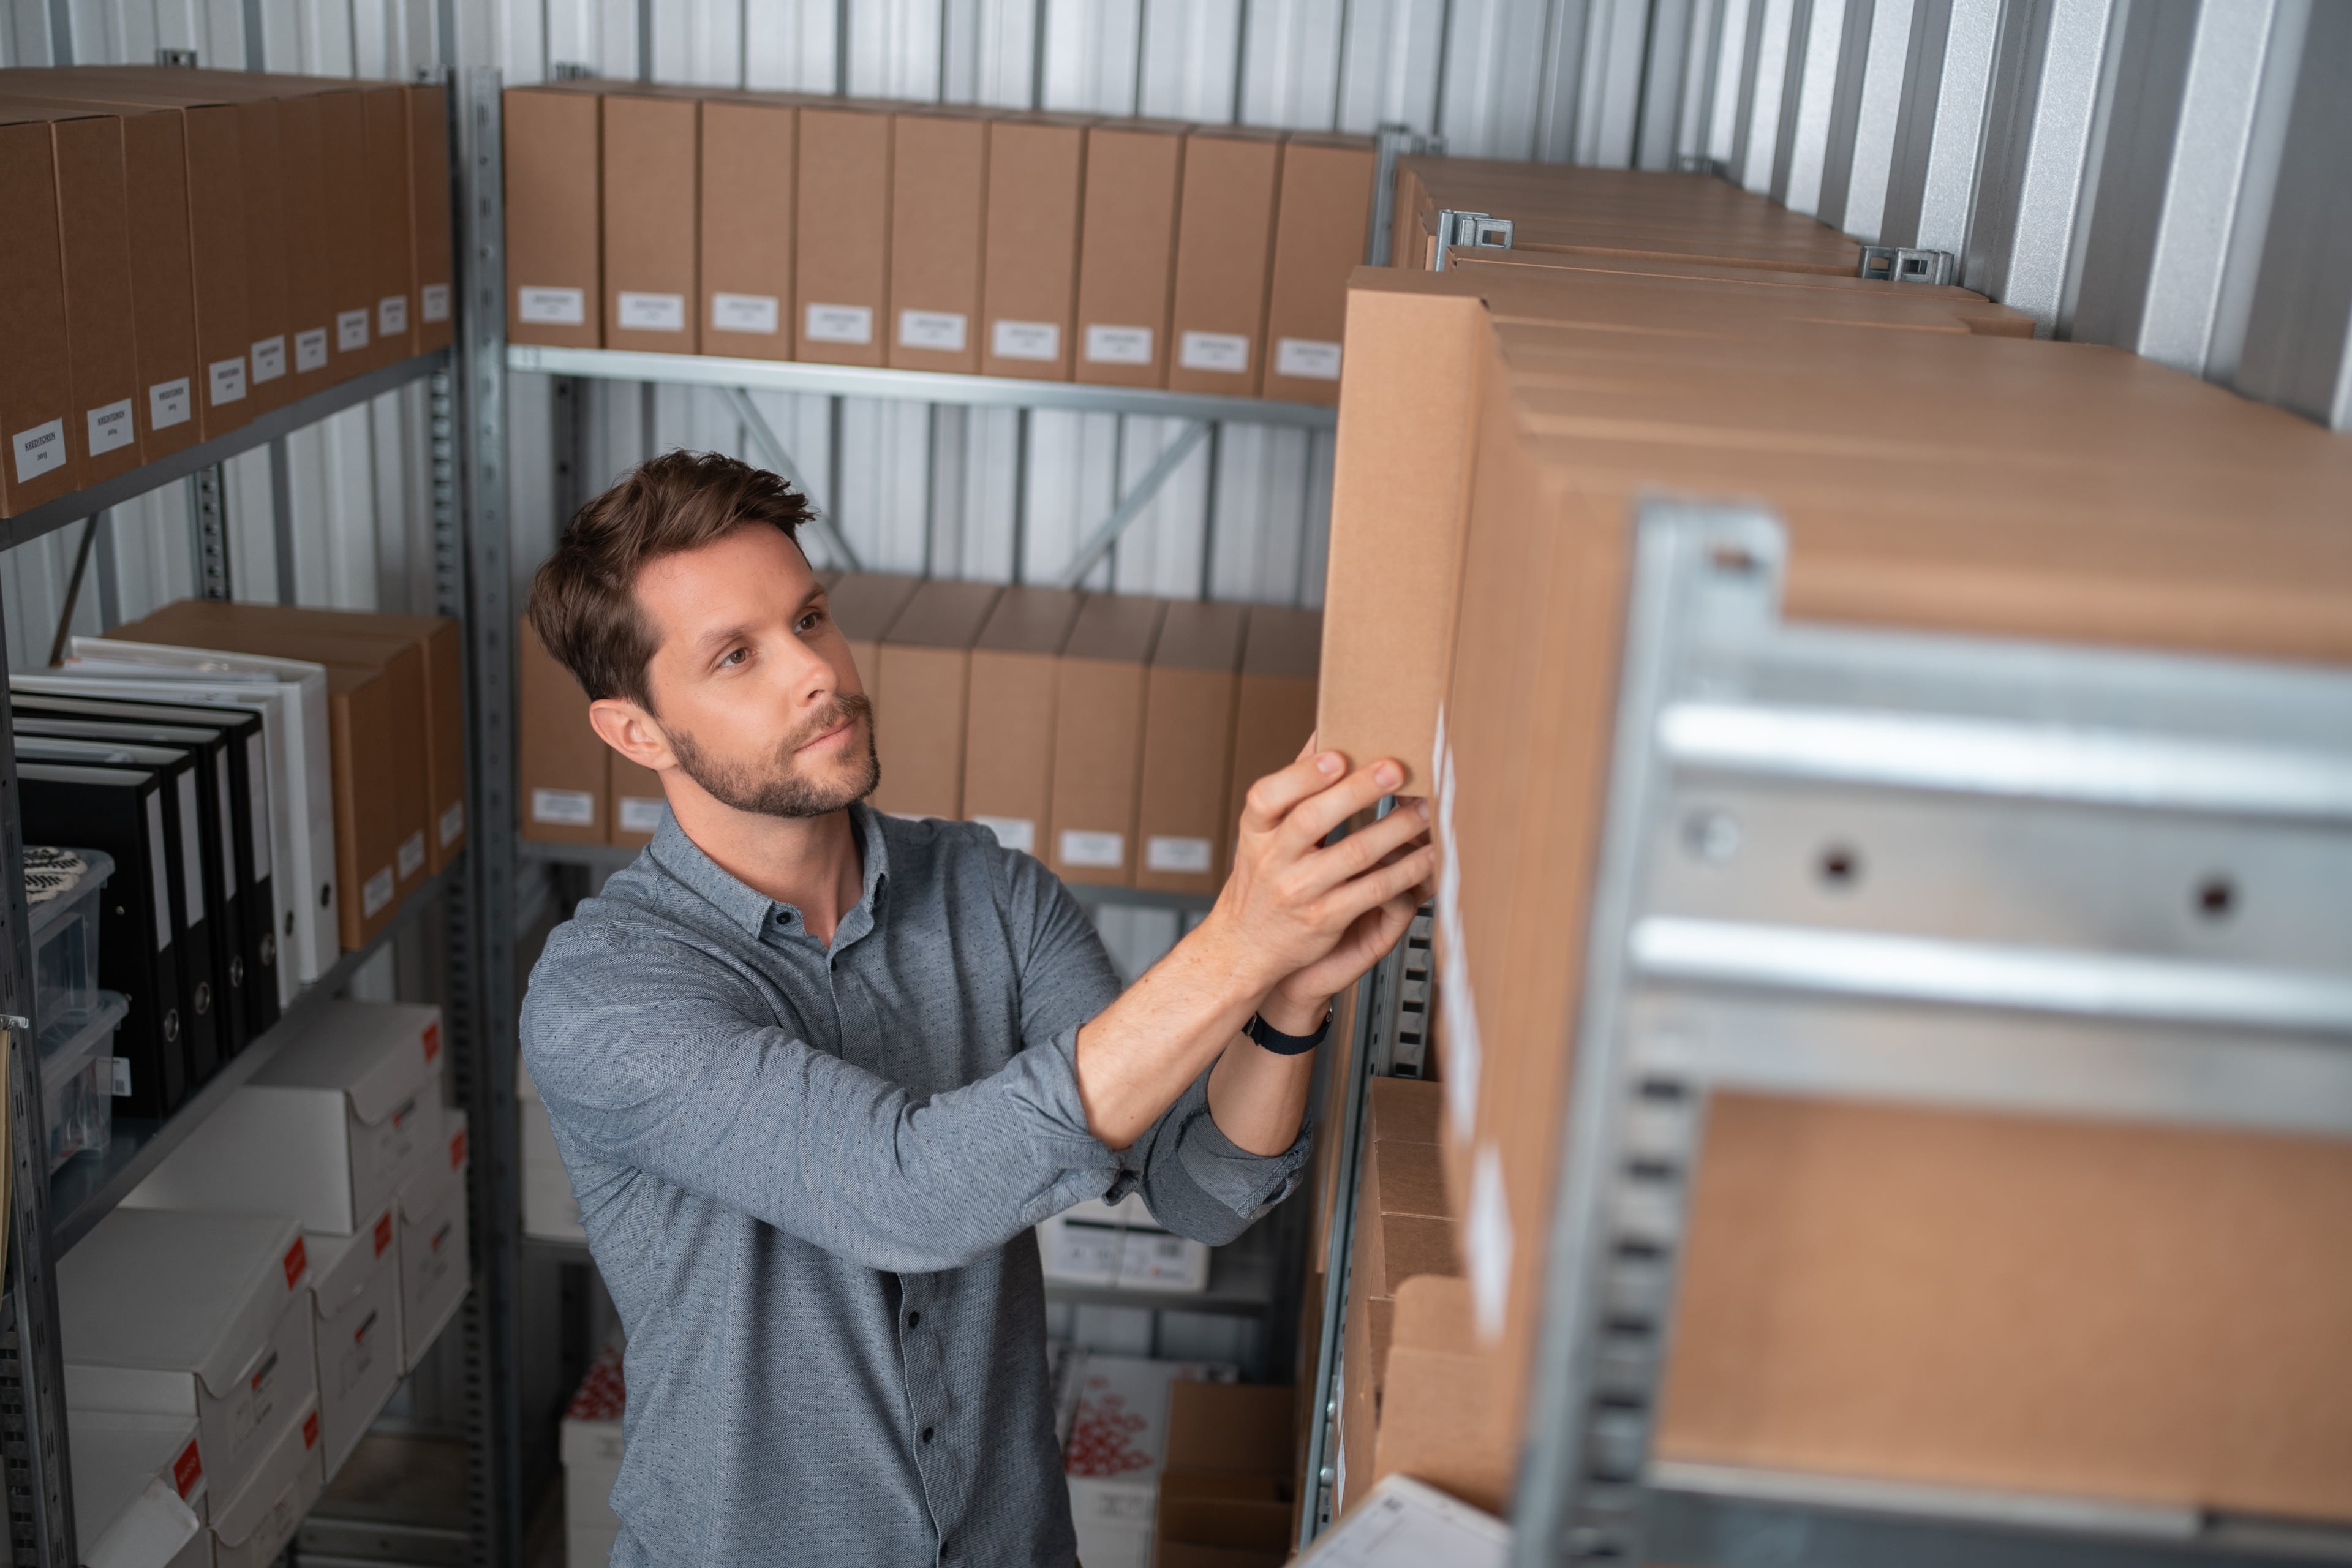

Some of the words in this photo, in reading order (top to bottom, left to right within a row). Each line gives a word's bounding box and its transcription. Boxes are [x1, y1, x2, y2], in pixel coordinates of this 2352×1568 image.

[98, 411, 125, 425] KREDITOREN
[25, 432, 55, 451] KREDITOREN
[38, 451, 48, 461] 2013
